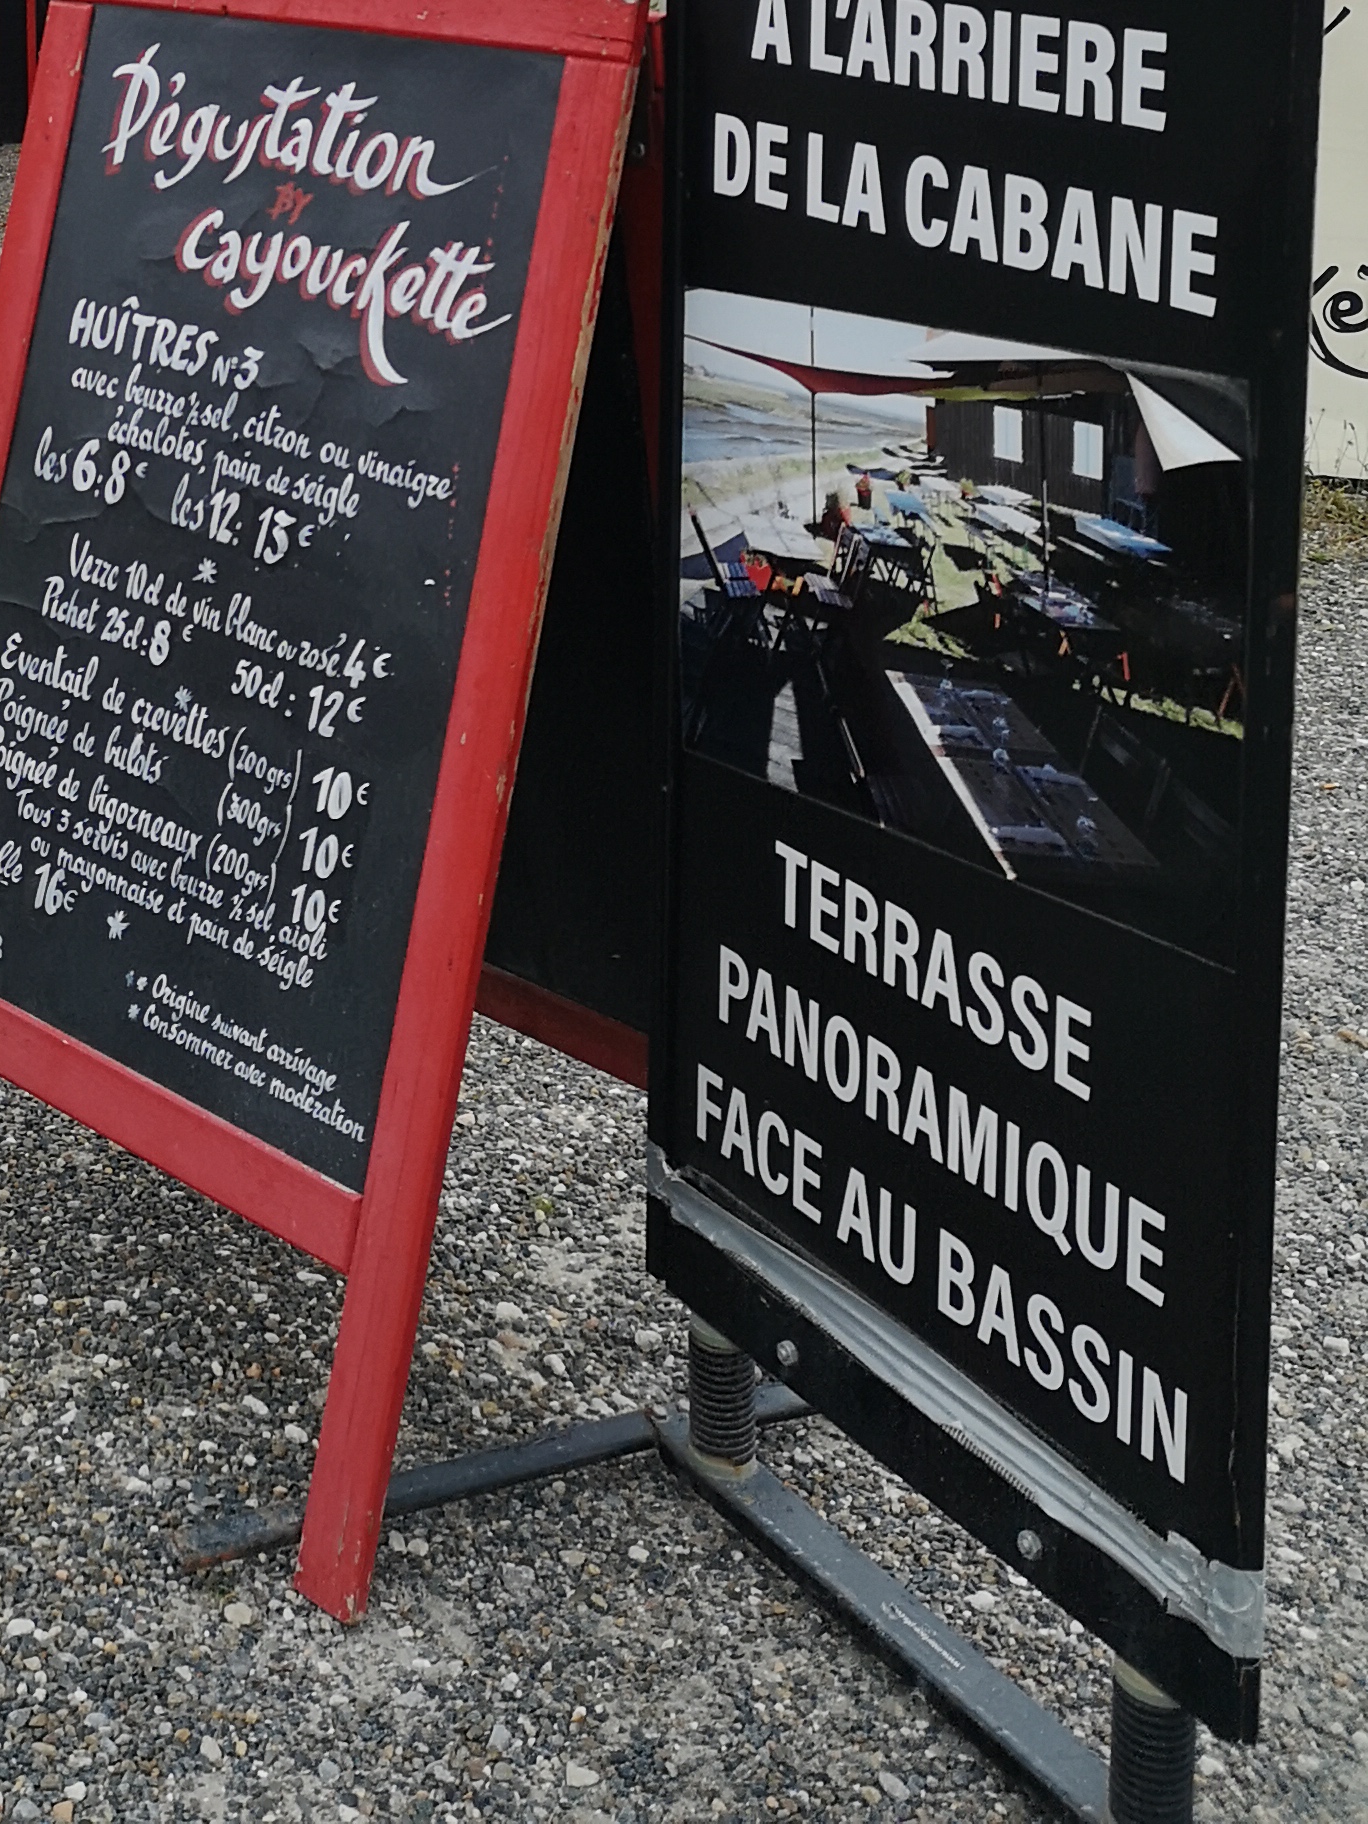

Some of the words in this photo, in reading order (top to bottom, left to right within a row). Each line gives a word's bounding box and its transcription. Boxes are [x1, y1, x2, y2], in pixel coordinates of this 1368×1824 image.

[101, 43, 498, 200] Dégustation
[713, 112, 789, 211] DE
[806, 131, 887, 236] LA
[904, 154, 1219, 319] CABANE
[69, 296, 220, 376] HUÎTRES
[175, 208, 513, 386] Cayouckette
[34, 425, 68, 484] les
[71, 366, 118, 400] avec
[125, 362, 185, 419] beurre
[242, 404, 312, 460] citron
[319, 441, 350, 469] ou
[357, 450, 453, 509] vinaigre
[212, 449, 262, 494] pain
[265, 464, 291, 496] de
[292, 473, 361, 526] seigle
[171, 473, 205, 529] les
[40, 574, 102, 634] Pichet
[69, 532, 118, 592] Verre
[165, 587, 189, 620] de
[192, 596, 222, 635] vin
[224, 591, 279, 656] blanc
[277, 639, 298, 664] ou
[0, 632, 100, 703] Eventail
[101, 677, 127, 716] de
[130, 697, 231, 760] crevettes
[72, 721, 97, 759] de
[103, 724, 171, 786] bulots
[15, 787, 54, 830] Tous
[56, 809, 71, 833] 3
[72, 818, 129, 862] servis
[130, 849, 168, 883] avec
[170, 849, 224, 910] beurre
[57, 767, 81, 803] de
[88, 774, 204, 863] bigorneaux
[30, 833, 51, 859] ou
[56, 847, 164, 915] mayonnaise
[168, 894, 186, 925] et
[187, 911, 231, 951] pain
[232, 927, 256, 961] de
[257, 944, 315, 992] seigle
[774, 839, 1093, 1103] TERRASSE
[142, 1003, 233, 1071] Consommer
[234, 1058, 267, 1087] avec
[151, 973, 211, 1023] Origine
[211, 1008, 268, 1055] suivant
[266, 1043, 338, 1095] arrivage
[718, 943, 1167, 1309] PANORAMIQUE
[696, 1062, 823, 1226] FACE
[835, 1165, 918, 1286] AU
[936, 1227, 1189, 1486] BASSIN
